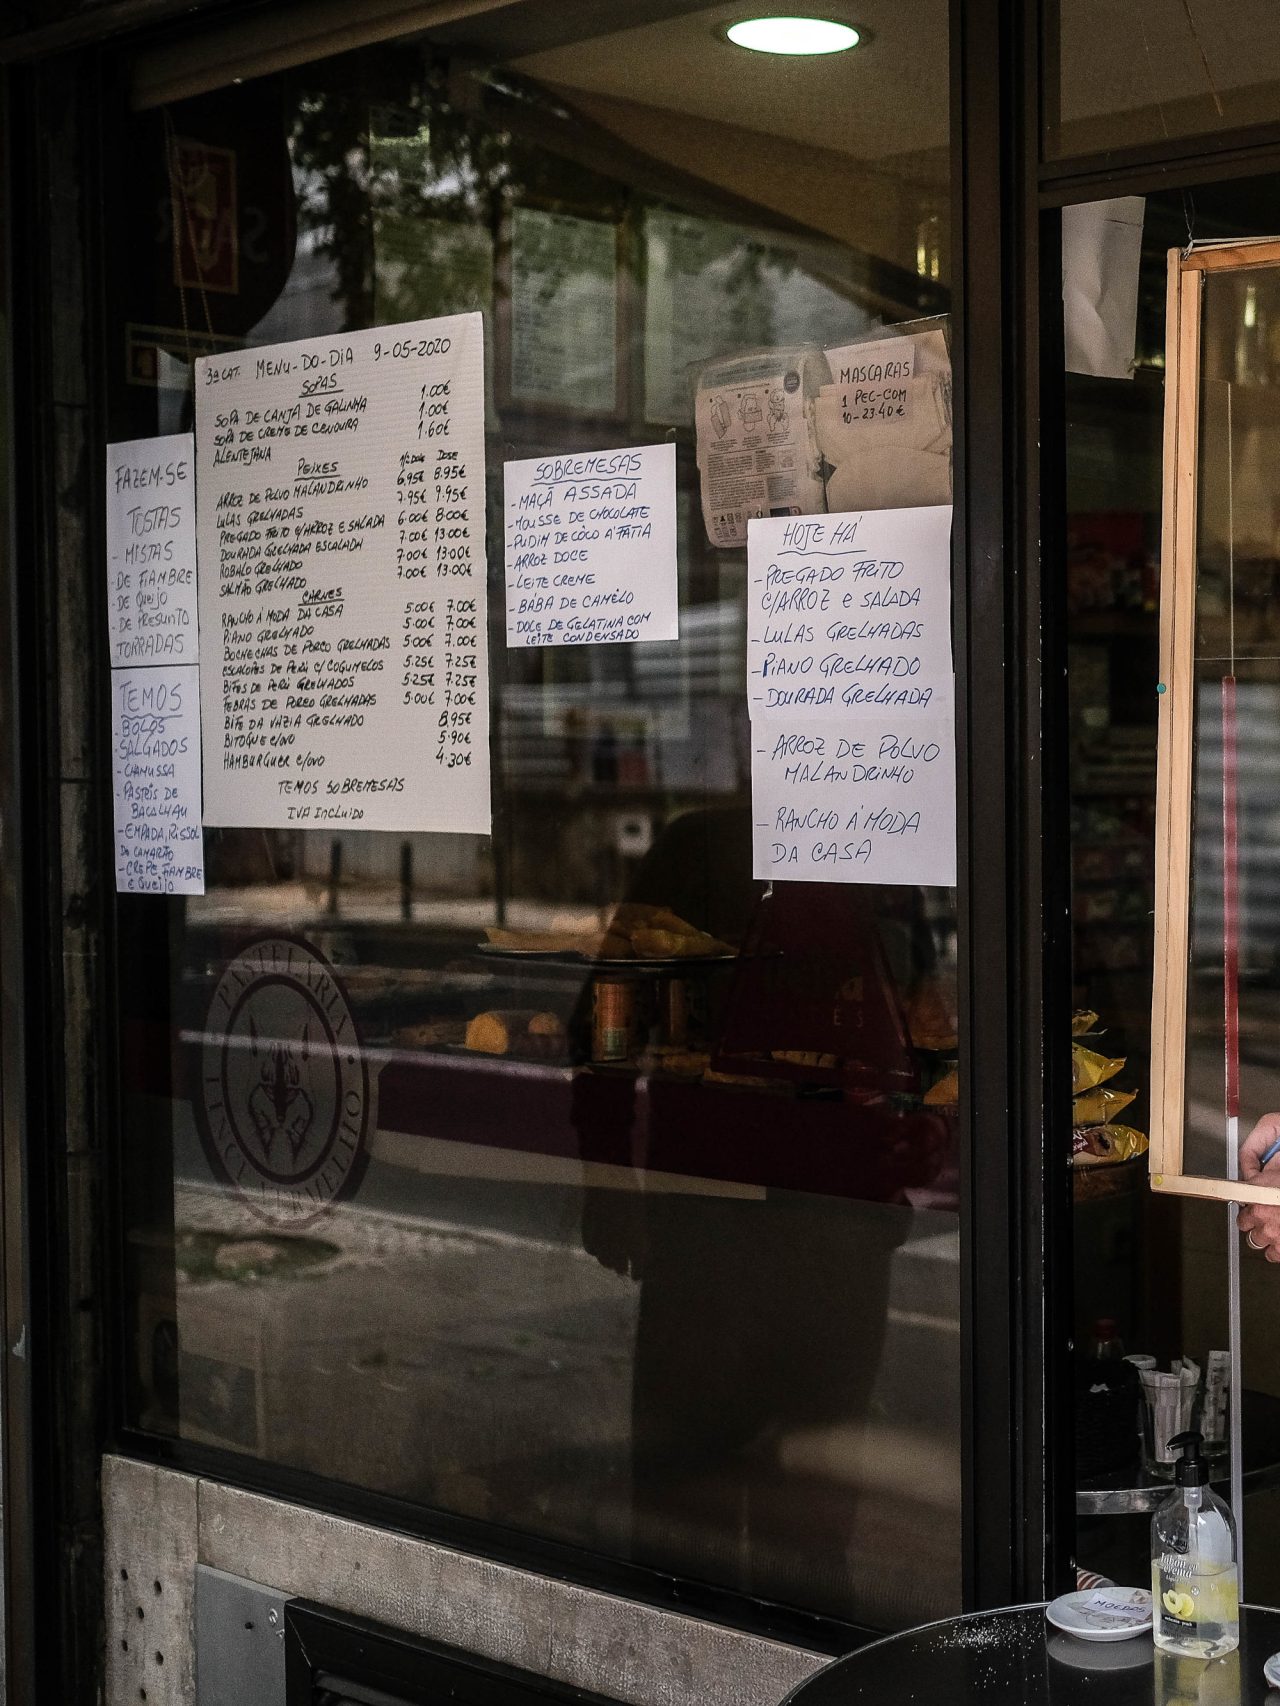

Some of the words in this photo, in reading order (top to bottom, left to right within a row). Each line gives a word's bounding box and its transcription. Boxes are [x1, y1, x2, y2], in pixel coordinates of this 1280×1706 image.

[374, 338, 451, 361] 9-05-2020
[840, 361, 911, 385] MASCARAS
[215, 409, 239, 428] SOPA
[306, 403, 320, 418] DE
[421, 380, 451, 400] 1.00€
[419, 400, 449, 420] 1.00€
[417, 419, 451, 440] 1.60€
[534, 453, 642, 482] SOBREMESAS
[564, 483, 637, 502] ASSADA
[126, 505, 182, 537] TOSTAS
[569, 511, 585, 524] DE
[555, 531, 568, 545] DE
[783, 522, 825, 551] HOJE
[554, 550, 589, 563] DOCE
[766, 564, 845, 590] PREGADO
[852, 560, 905, 582] FRITO
[315, 604, 344, 618] CASA
[404, 601, 435, 614] 5.00€
[447, 598, 477, 613] 7.00€
[559, 597, 577, 610] DE
[860, 586, 921, 610] SALADA
[402, 616, 435, 629] 5.00€
[763, 622, 814, 644] LULAS
[826, 620, 925, 642] GRELHADAS
[116, 632, 185, 659] TORRADAS
[562, 629, 640, 643] CONDENSADO
[819, 653, 921, 678] GRELHADO
[119, 680, 183, 713] TEMOS
[403, 691, 435, 705] 5.00€
[765, 687, 835, 708] DOURADA
[841, 683, 933, 708] GRELHADA
[771, 734, 826, 761] ARROZ
[835, 738, 866, 759] DE
[878, 734, 941, 762] POLVO
[277, 779, 318, 795] TEMOS
[775, 806, 839, 833] RANCHO
[864, 807, 922, 836] MODA
[771, 842, 798, 864] DA
[811, 839, 872, 864] CASA
